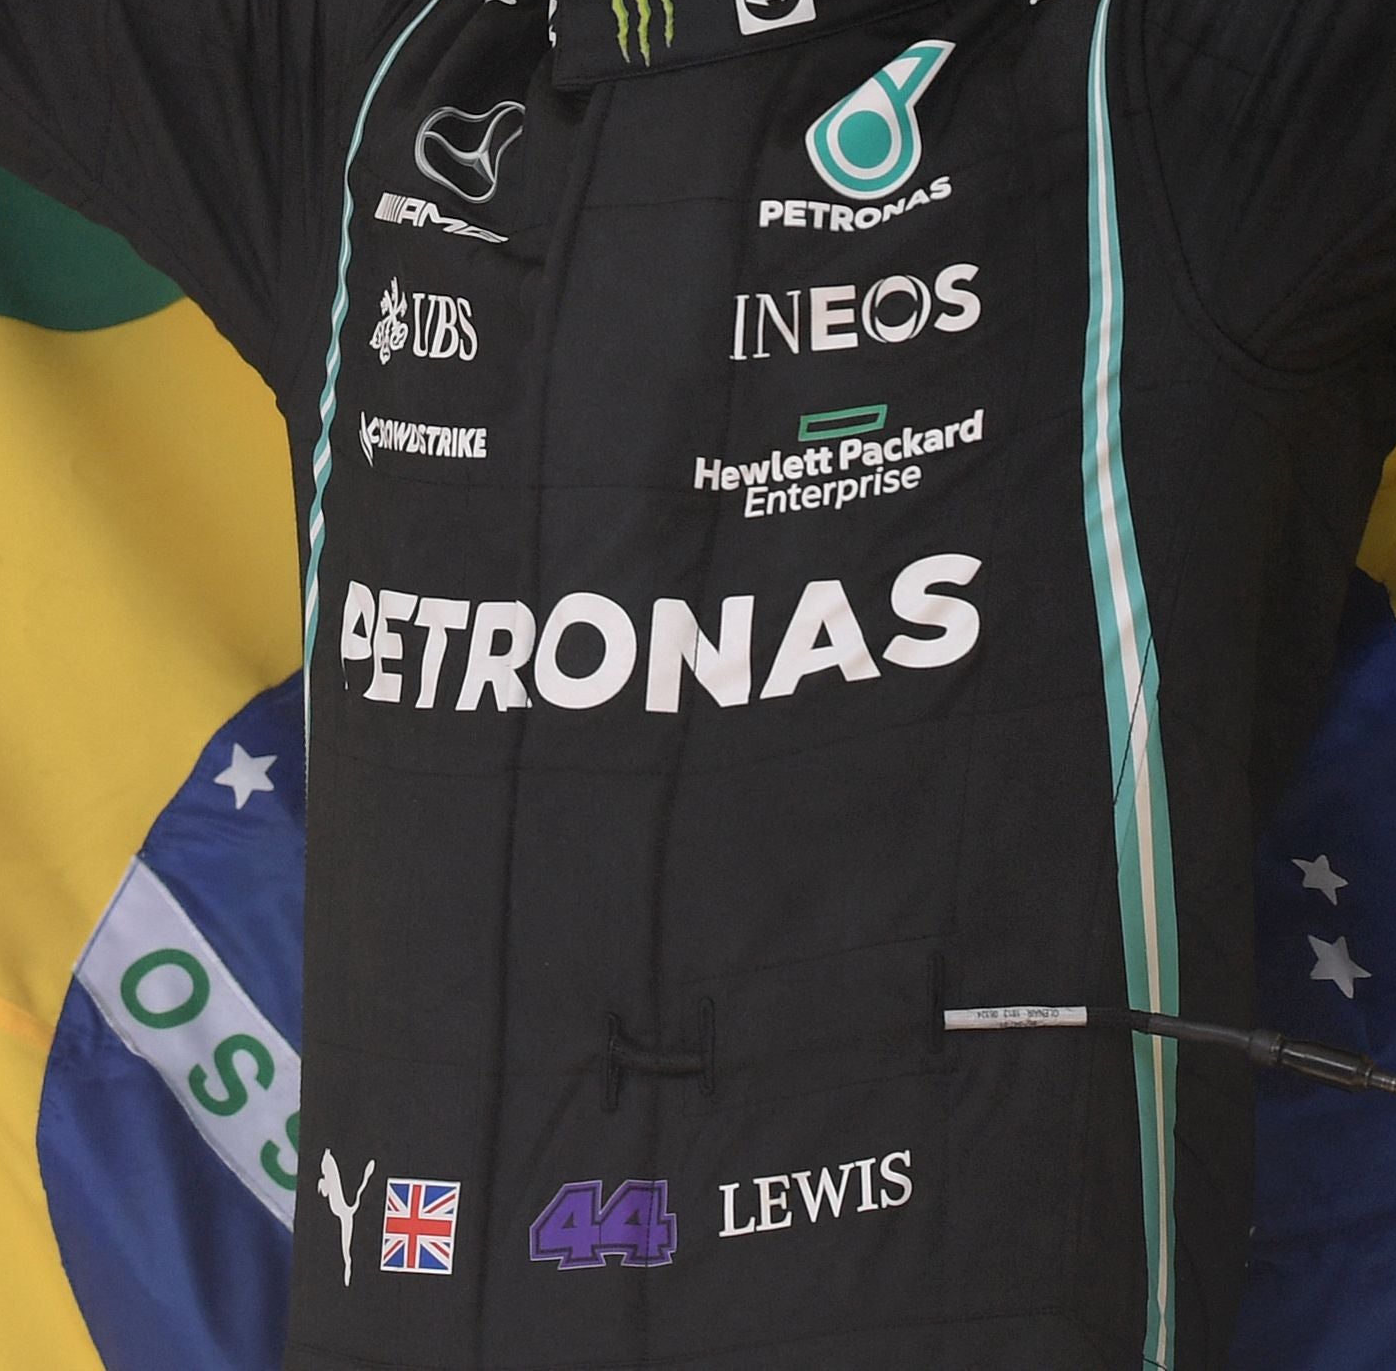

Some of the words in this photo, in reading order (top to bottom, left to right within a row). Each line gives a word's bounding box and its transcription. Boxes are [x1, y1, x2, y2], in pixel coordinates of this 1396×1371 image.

[759, 175, 953, 232] PETRONAS
[412, 293, 478, 361] UBS
[729, 263, 982, 361] INEOS
[693, 446, 834, 492] Hewlett
[839, 409, 985, 470] Packard
[744, 464, 922, 518] Enterprise
[340, 553, 982, 713] PETRONAS
[529, 1178, 678, 1271] 44
[718, 1150, 914, 1238] LEWIS
